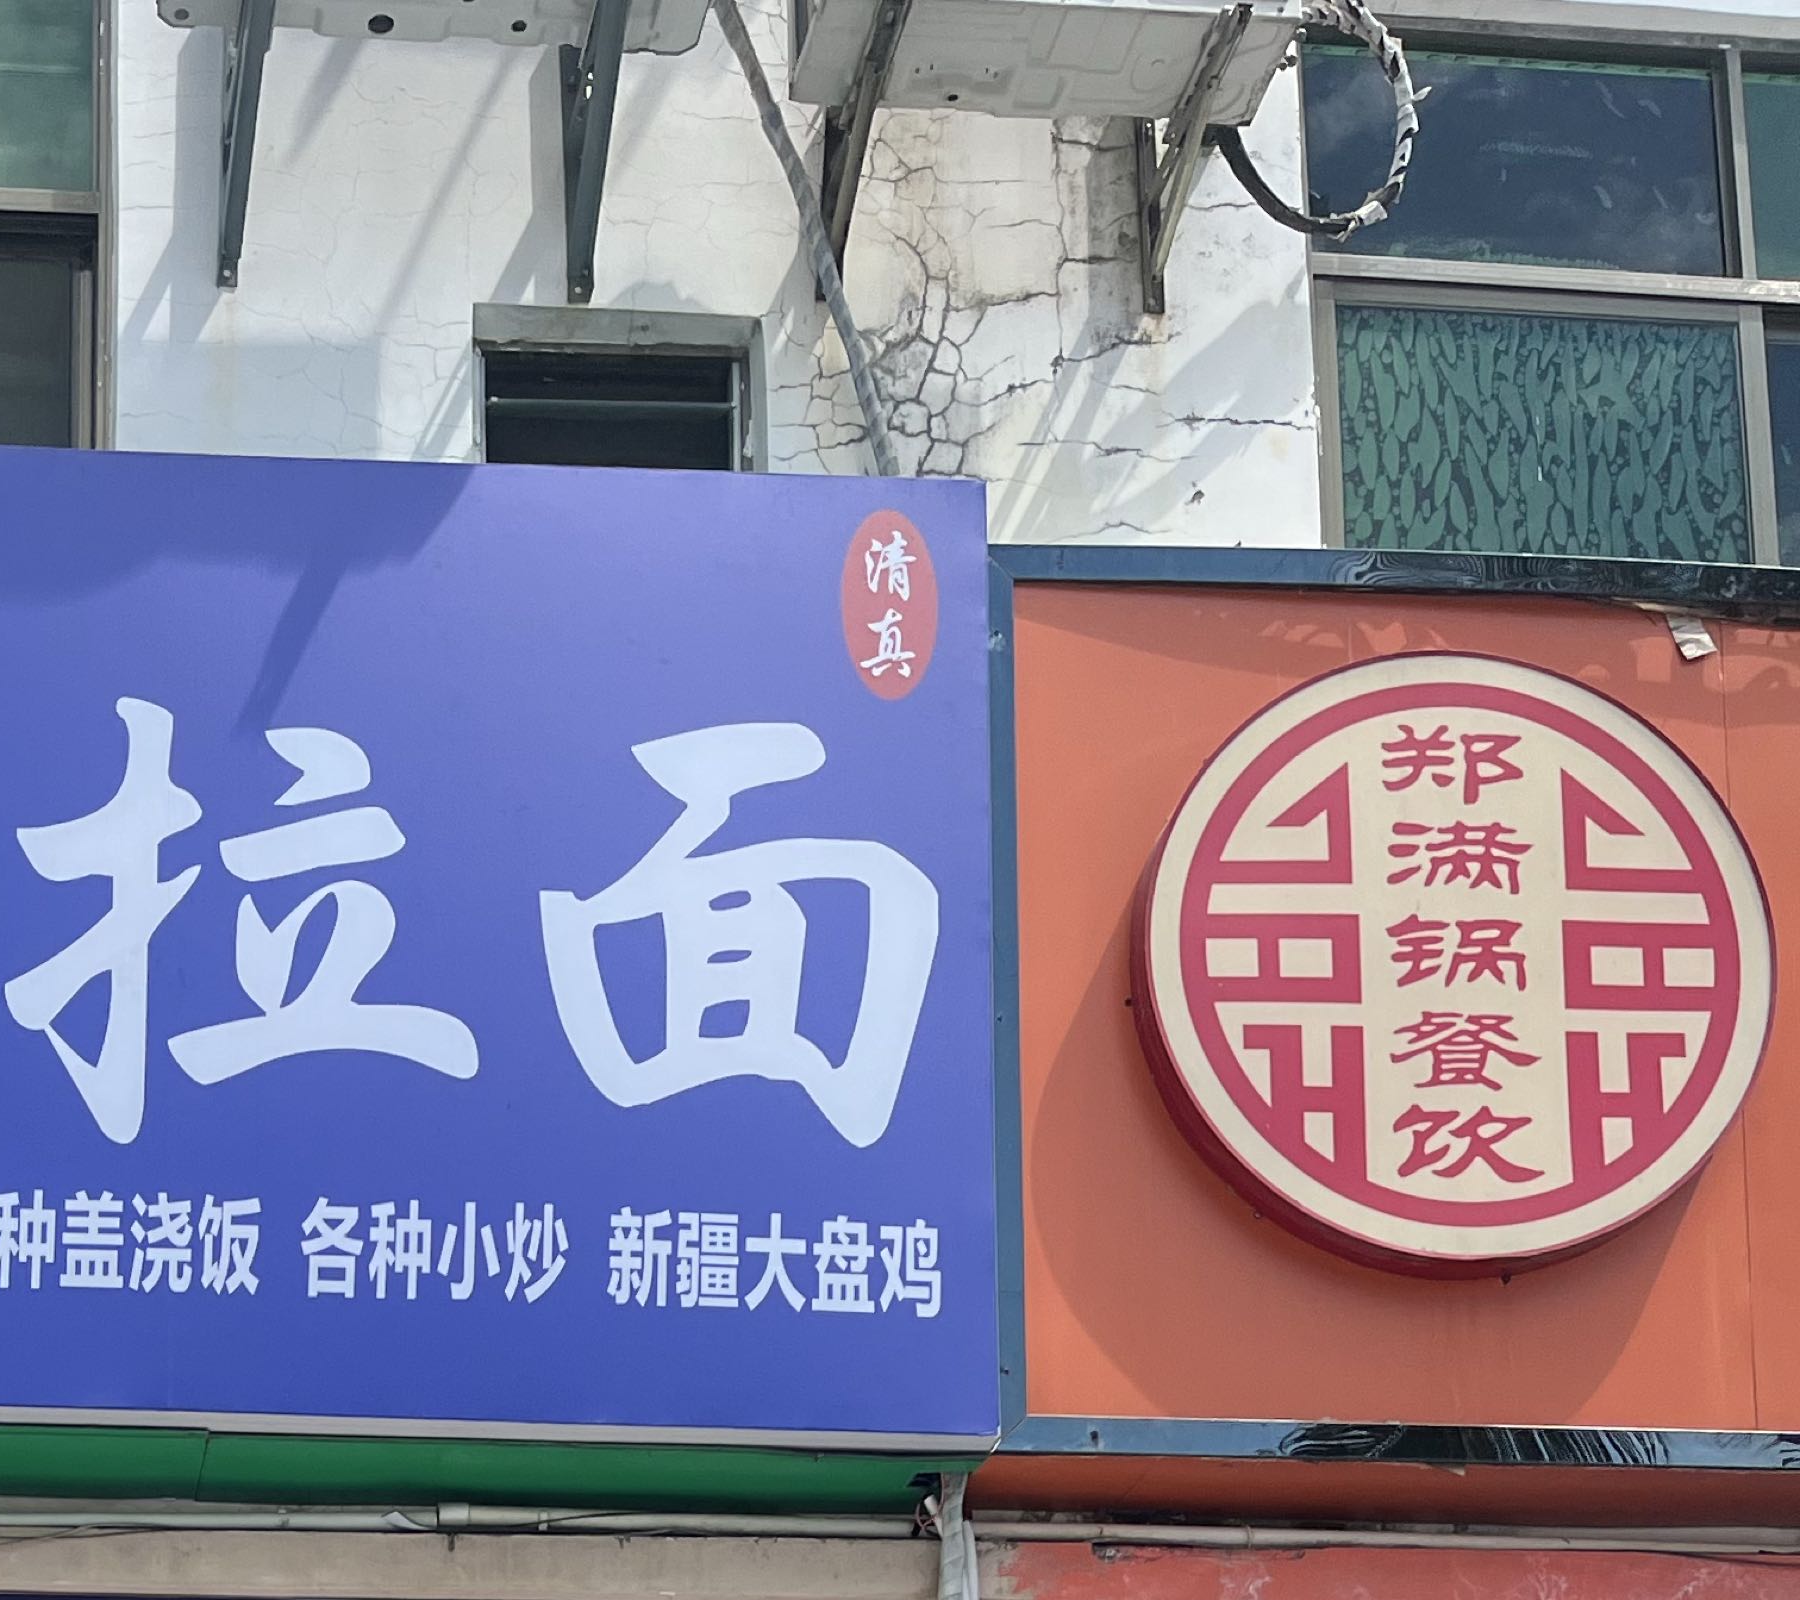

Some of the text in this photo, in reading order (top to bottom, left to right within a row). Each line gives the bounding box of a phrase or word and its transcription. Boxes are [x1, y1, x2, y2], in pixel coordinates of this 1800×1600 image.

[860, 531, 918, 679] 清真
[1381, 724, 1546, 1183] 郑满锅餐饮
[299, 1196, 571, 1305] 各种小炒
[606, 1206, 944, 1318] 新疆大盘鸡
